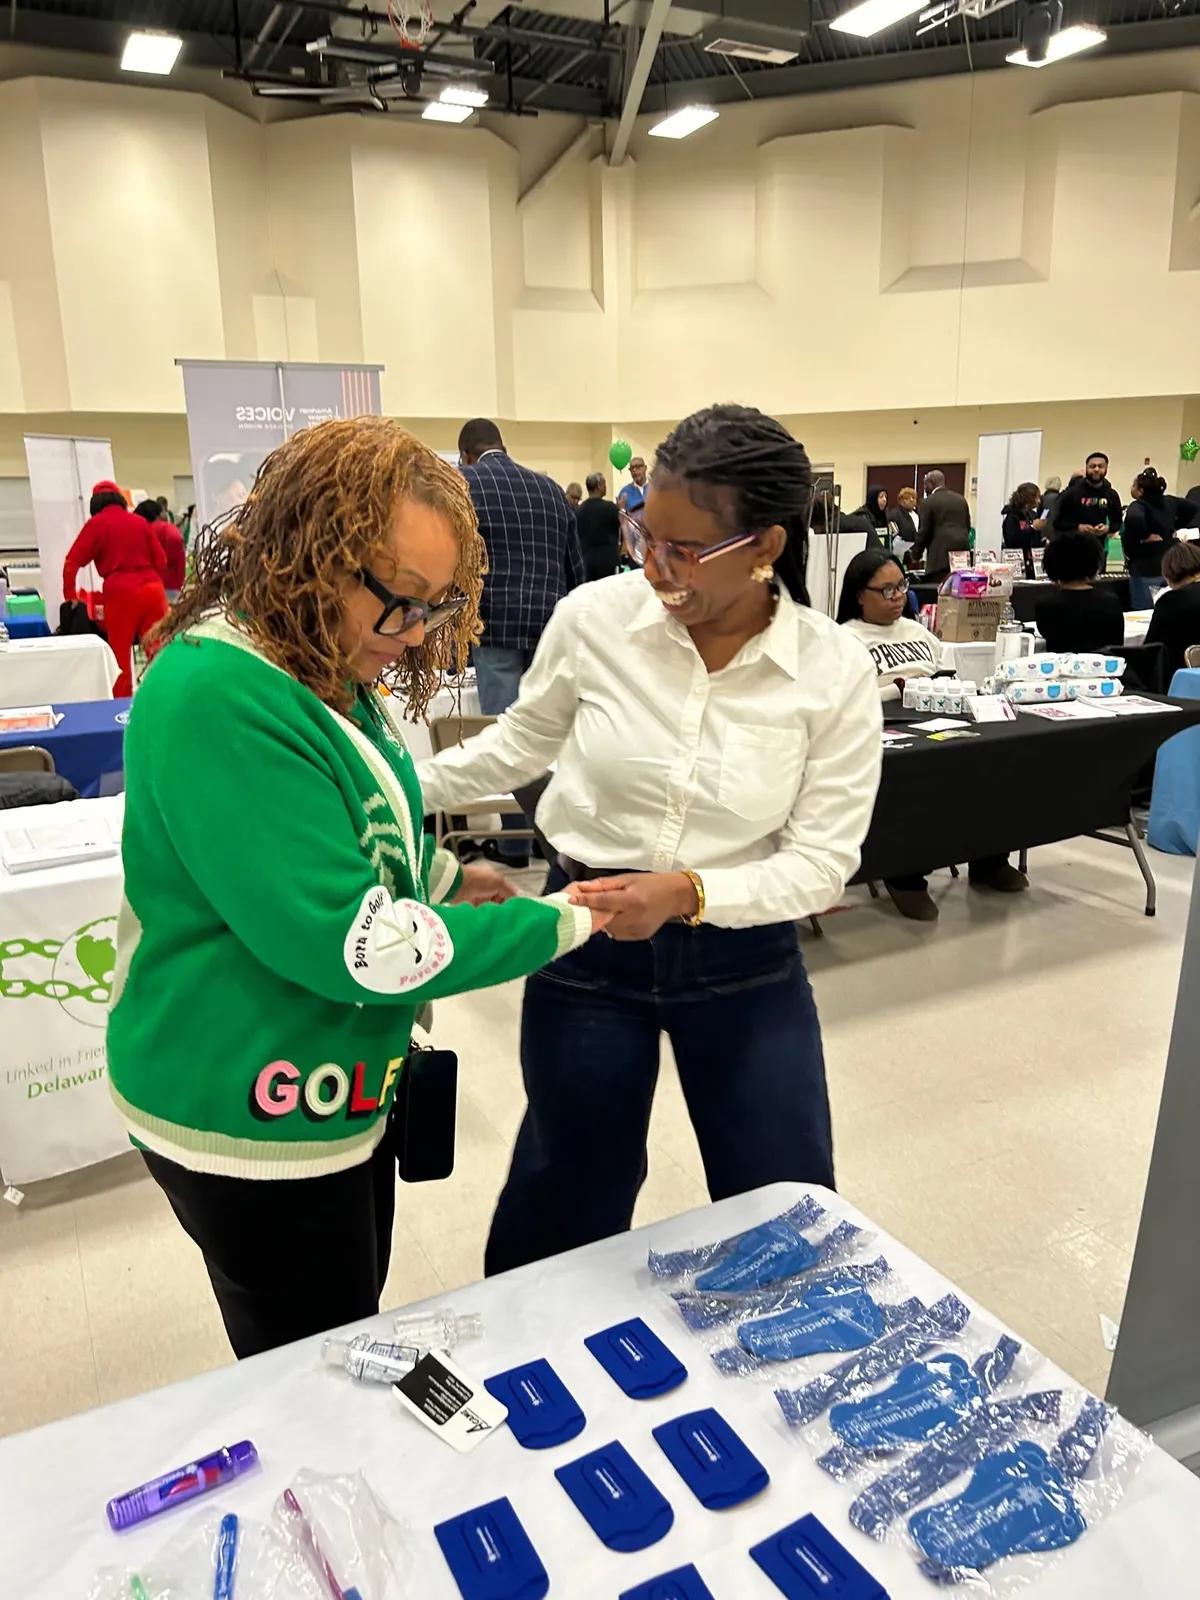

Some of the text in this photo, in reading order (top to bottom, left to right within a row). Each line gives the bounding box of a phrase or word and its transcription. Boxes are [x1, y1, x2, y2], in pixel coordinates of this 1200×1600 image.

[354, 892, 384, 970] Born to Golf
[6, 1057, 53, 1084] Linked
[59, 1056, 72, 1069] in
[27, 1065, 106, 1099] Delawar
[254, 1057, 404, 1116] GOLF
